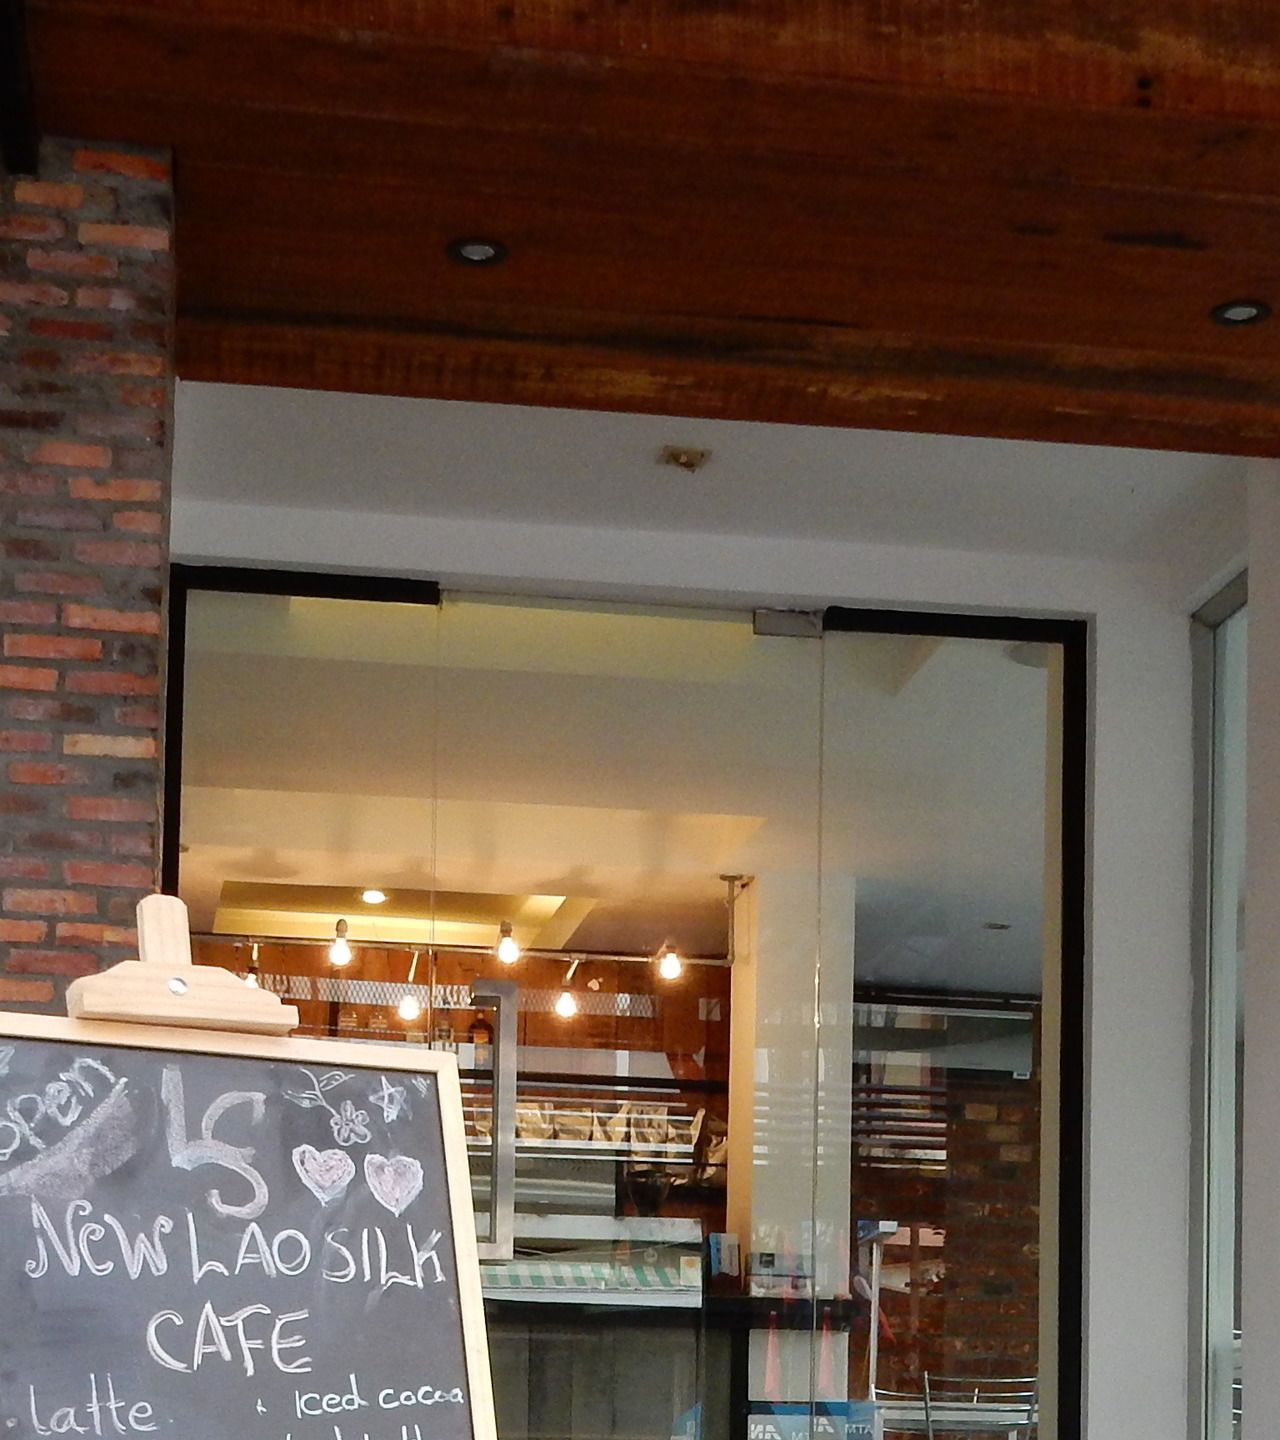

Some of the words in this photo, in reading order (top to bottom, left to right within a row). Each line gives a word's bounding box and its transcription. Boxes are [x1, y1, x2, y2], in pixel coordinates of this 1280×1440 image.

[186, 1211, 312, 1284] LAO
[322, 1223, 446, 1289] SILK
[146, 1300, 312, 1377] CAFE
[295, 1373, 369, 1419] Iced
